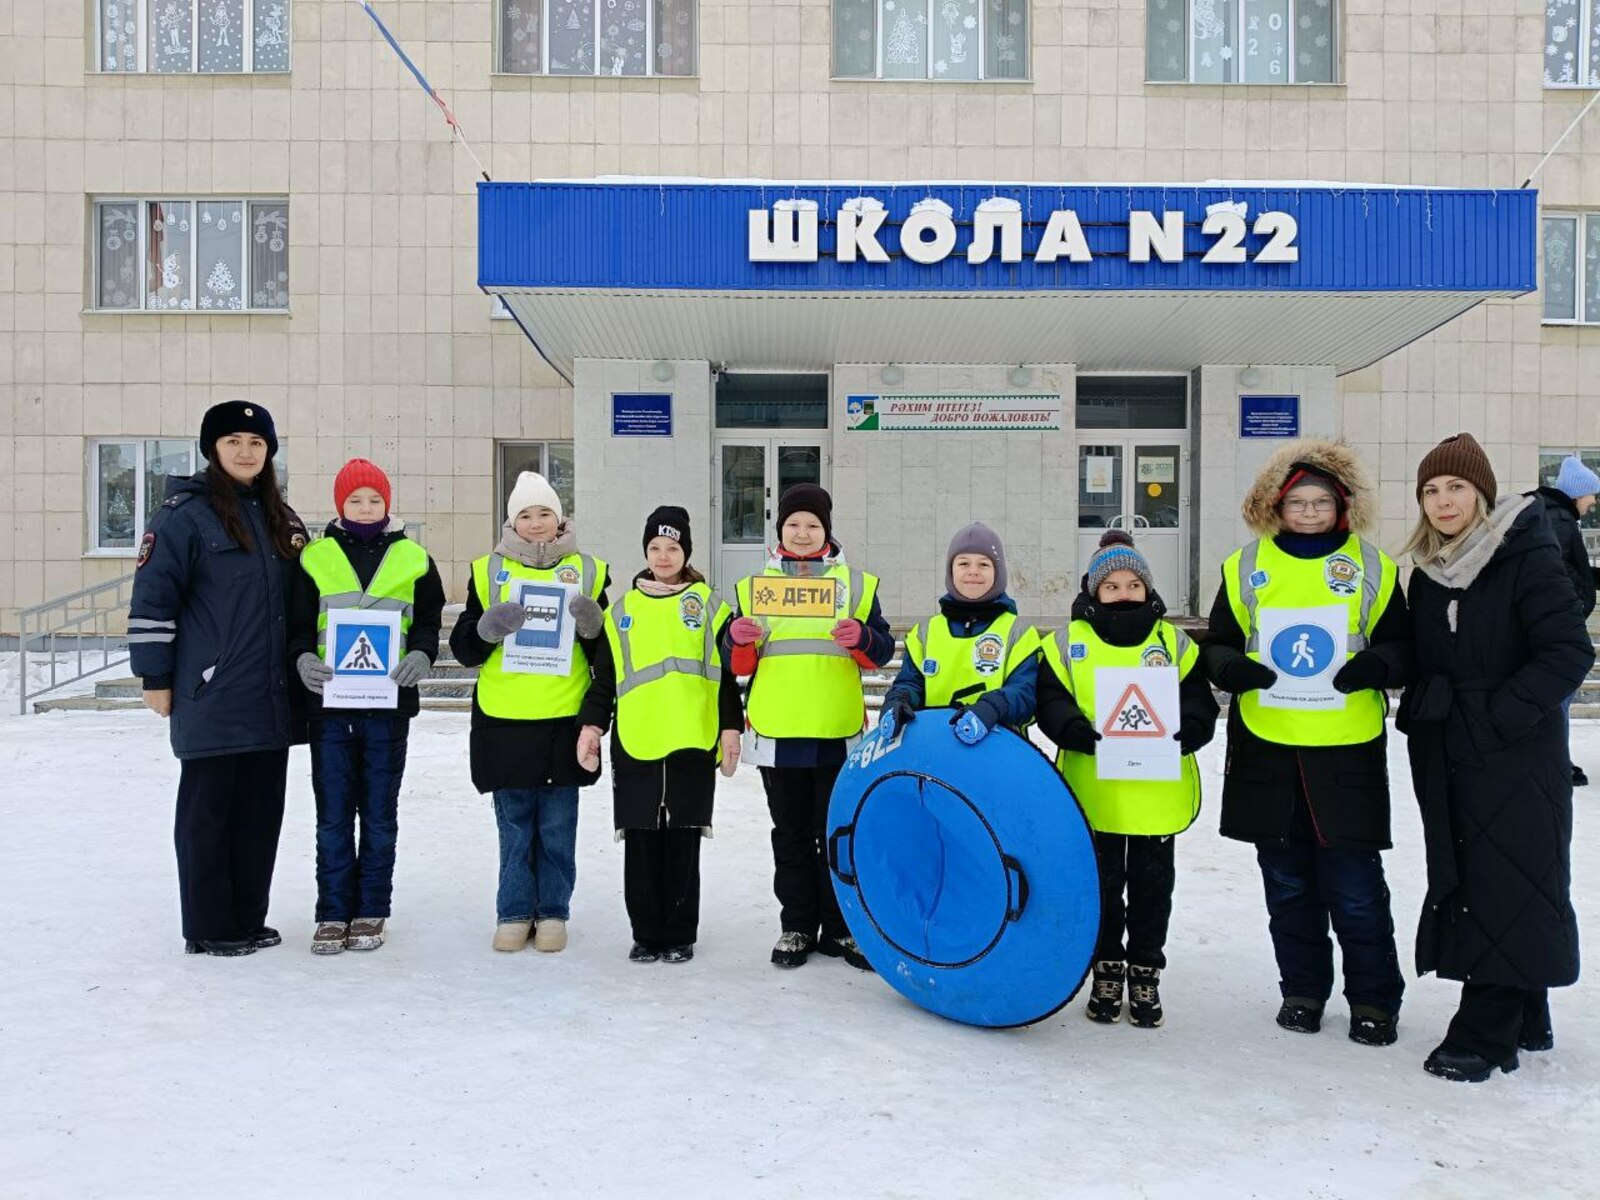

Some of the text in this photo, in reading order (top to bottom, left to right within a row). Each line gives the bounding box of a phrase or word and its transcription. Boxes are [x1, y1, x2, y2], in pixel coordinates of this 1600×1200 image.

[748, 207, 1093, 264] ШКОЛА
[930, 412, 1051, 423] ДОБРО ПОЖАЛОВАТЬ!
[782, 586, 832, 607] ДЕТИ
